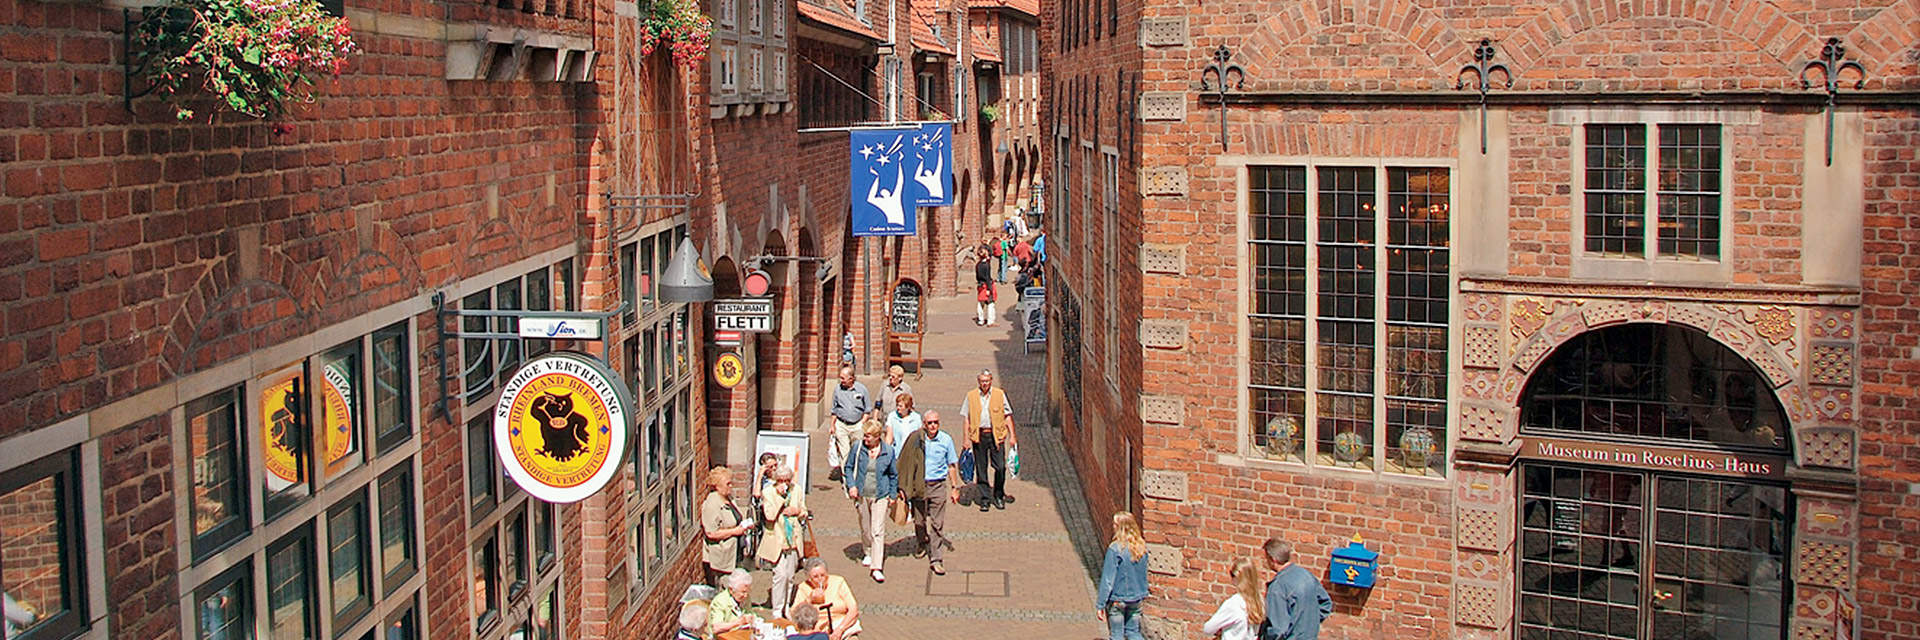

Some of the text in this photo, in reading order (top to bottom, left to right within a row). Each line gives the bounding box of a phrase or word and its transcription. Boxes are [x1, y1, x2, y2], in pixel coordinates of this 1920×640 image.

[717, 304, 766, 312] RESTAURANT
[717, 316, 767, 329] FLETT
[512, 376, 606, 422] RHEINLAND BREMEN
[545, 360, 620, 415] VERTRETUNG
[556, 443, 606, 485] VERTRETUNG
[1538, 442, 1770, 475] Museum im Roselius-Haus
